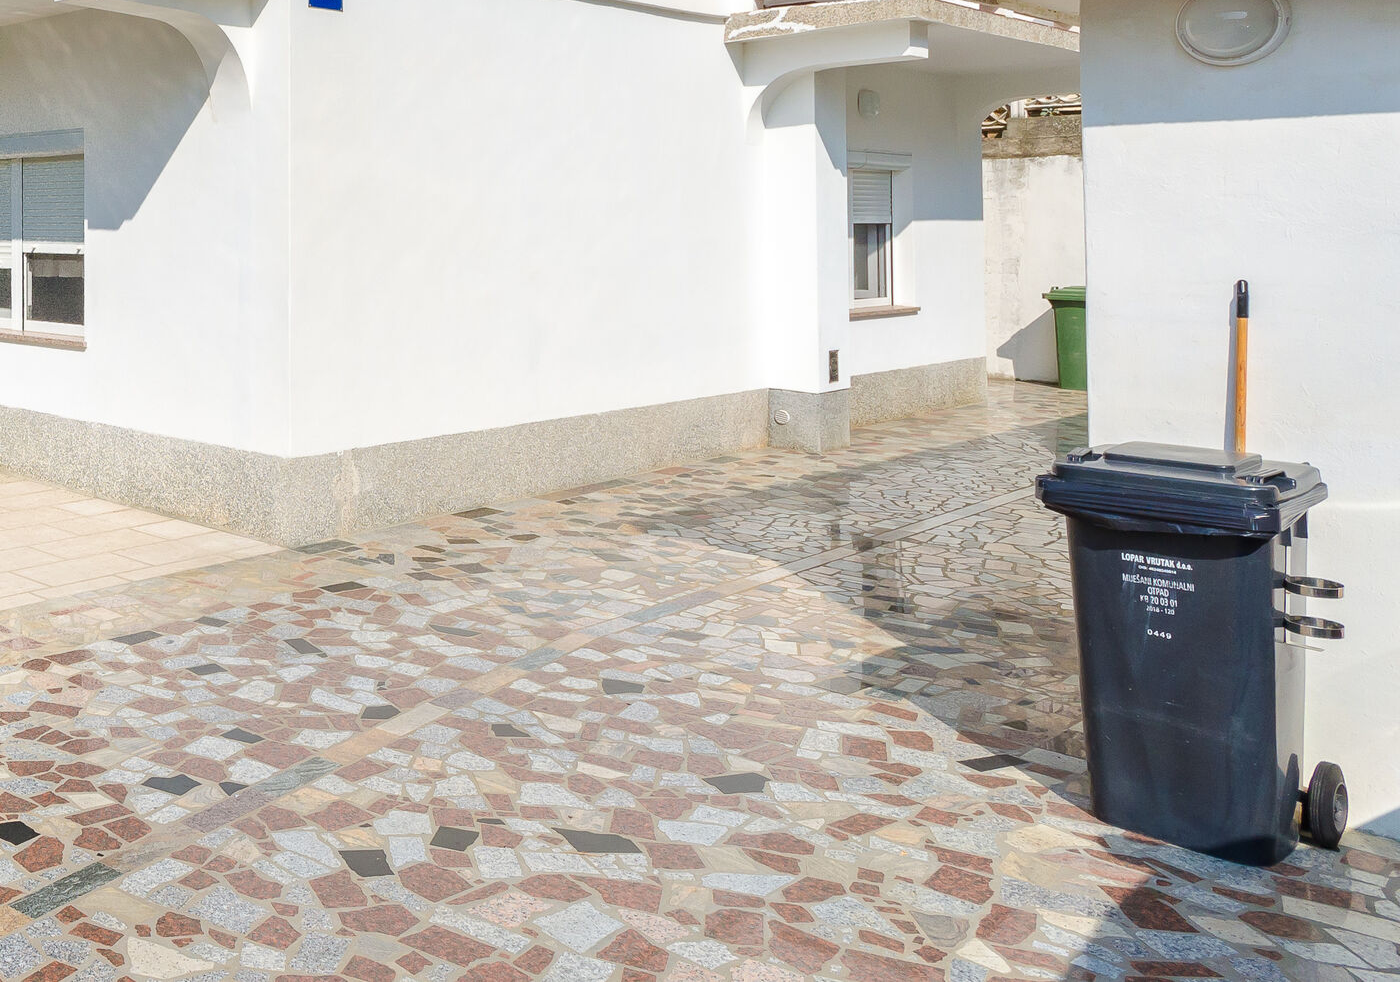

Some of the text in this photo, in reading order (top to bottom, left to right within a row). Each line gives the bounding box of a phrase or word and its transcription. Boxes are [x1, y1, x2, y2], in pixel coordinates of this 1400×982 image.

[1121, 552, 1145, 563] LOPAR
[1146, 556, 1175, 568] VRUTAK
[1176, 561, 1193, 571] d.o.o.
[1153, 577, 1195, 592] KOMUNALNI
[1147, 586, 1169, 597] OTPAD
[1150, 596, 1159, 605] 20
[1160, 597, 1168, 606] 03
[1169, 599, 1178, 607] 01
[1147, 629, 1172, 639] 0449
